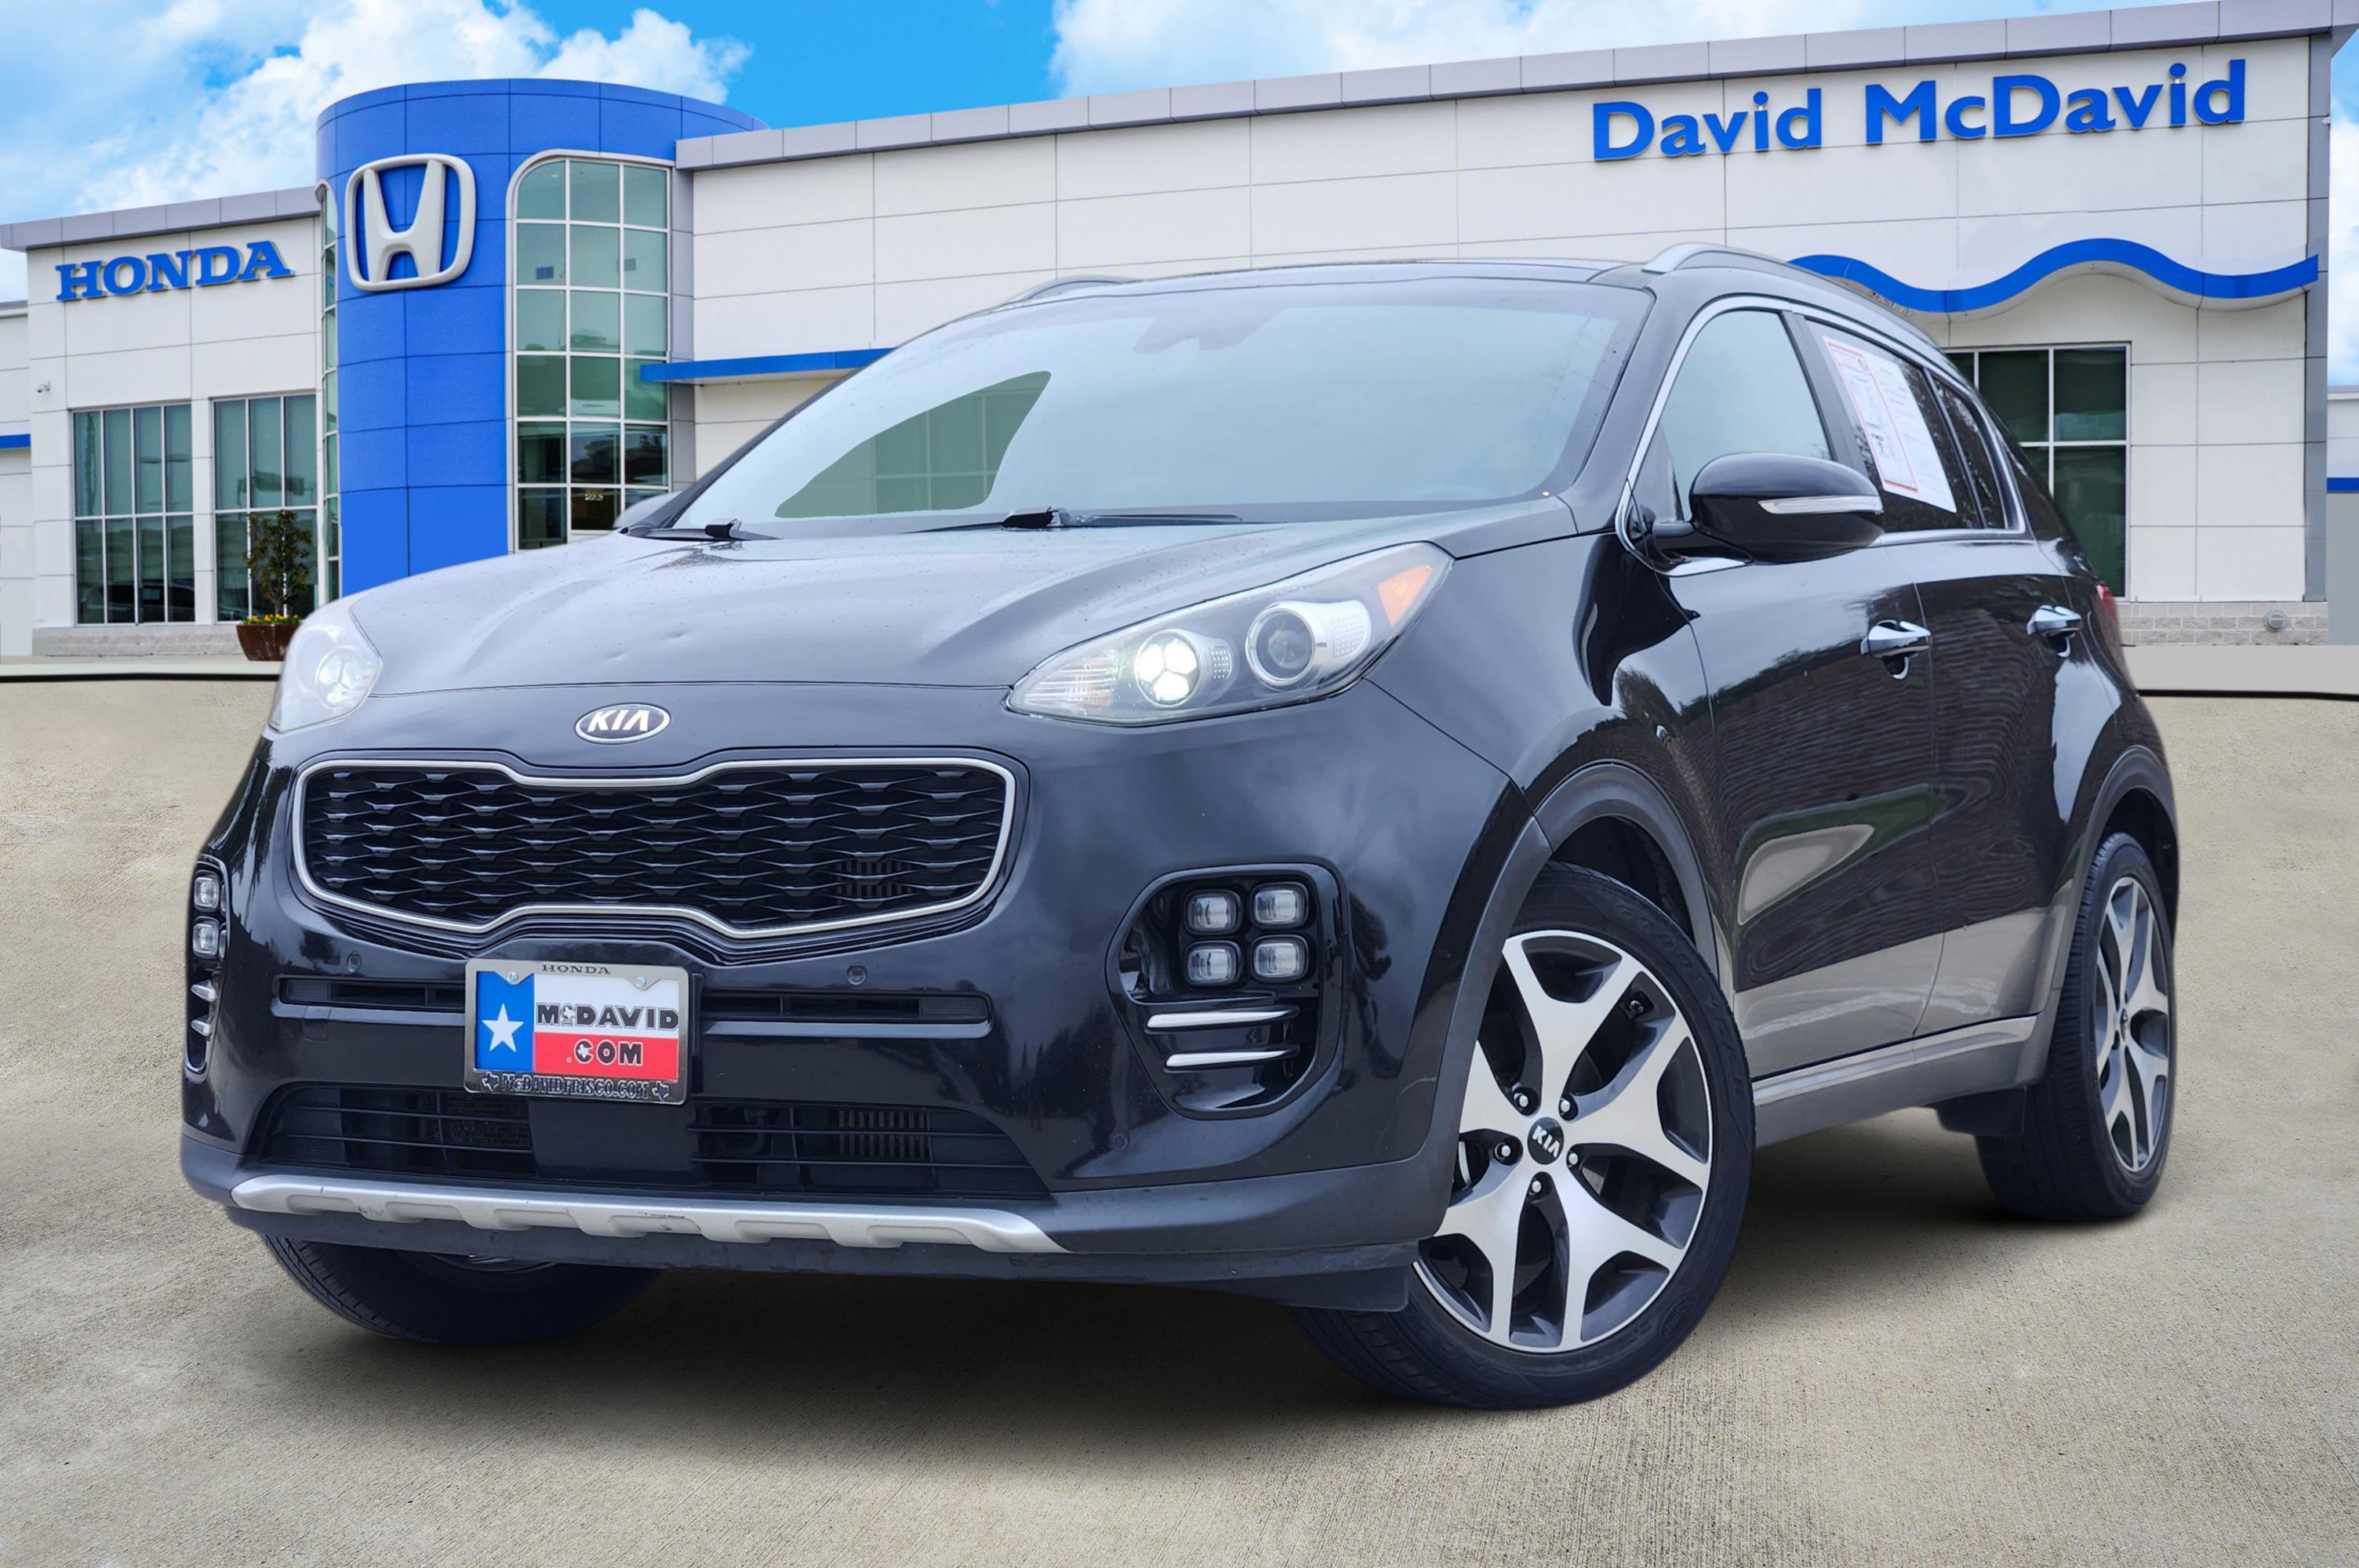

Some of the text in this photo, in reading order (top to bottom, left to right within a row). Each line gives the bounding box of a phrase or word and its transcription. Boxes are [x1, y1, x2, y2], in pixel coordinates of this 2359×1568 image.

[1593, 59, 2246, 162] David McDavid
[55, 240, 295, 301] HONDA
[587, 709, 650, 732] KIA
[541, 964, 611, 975] HONDA
[1532, 1124, 1560, 1159] KIA
